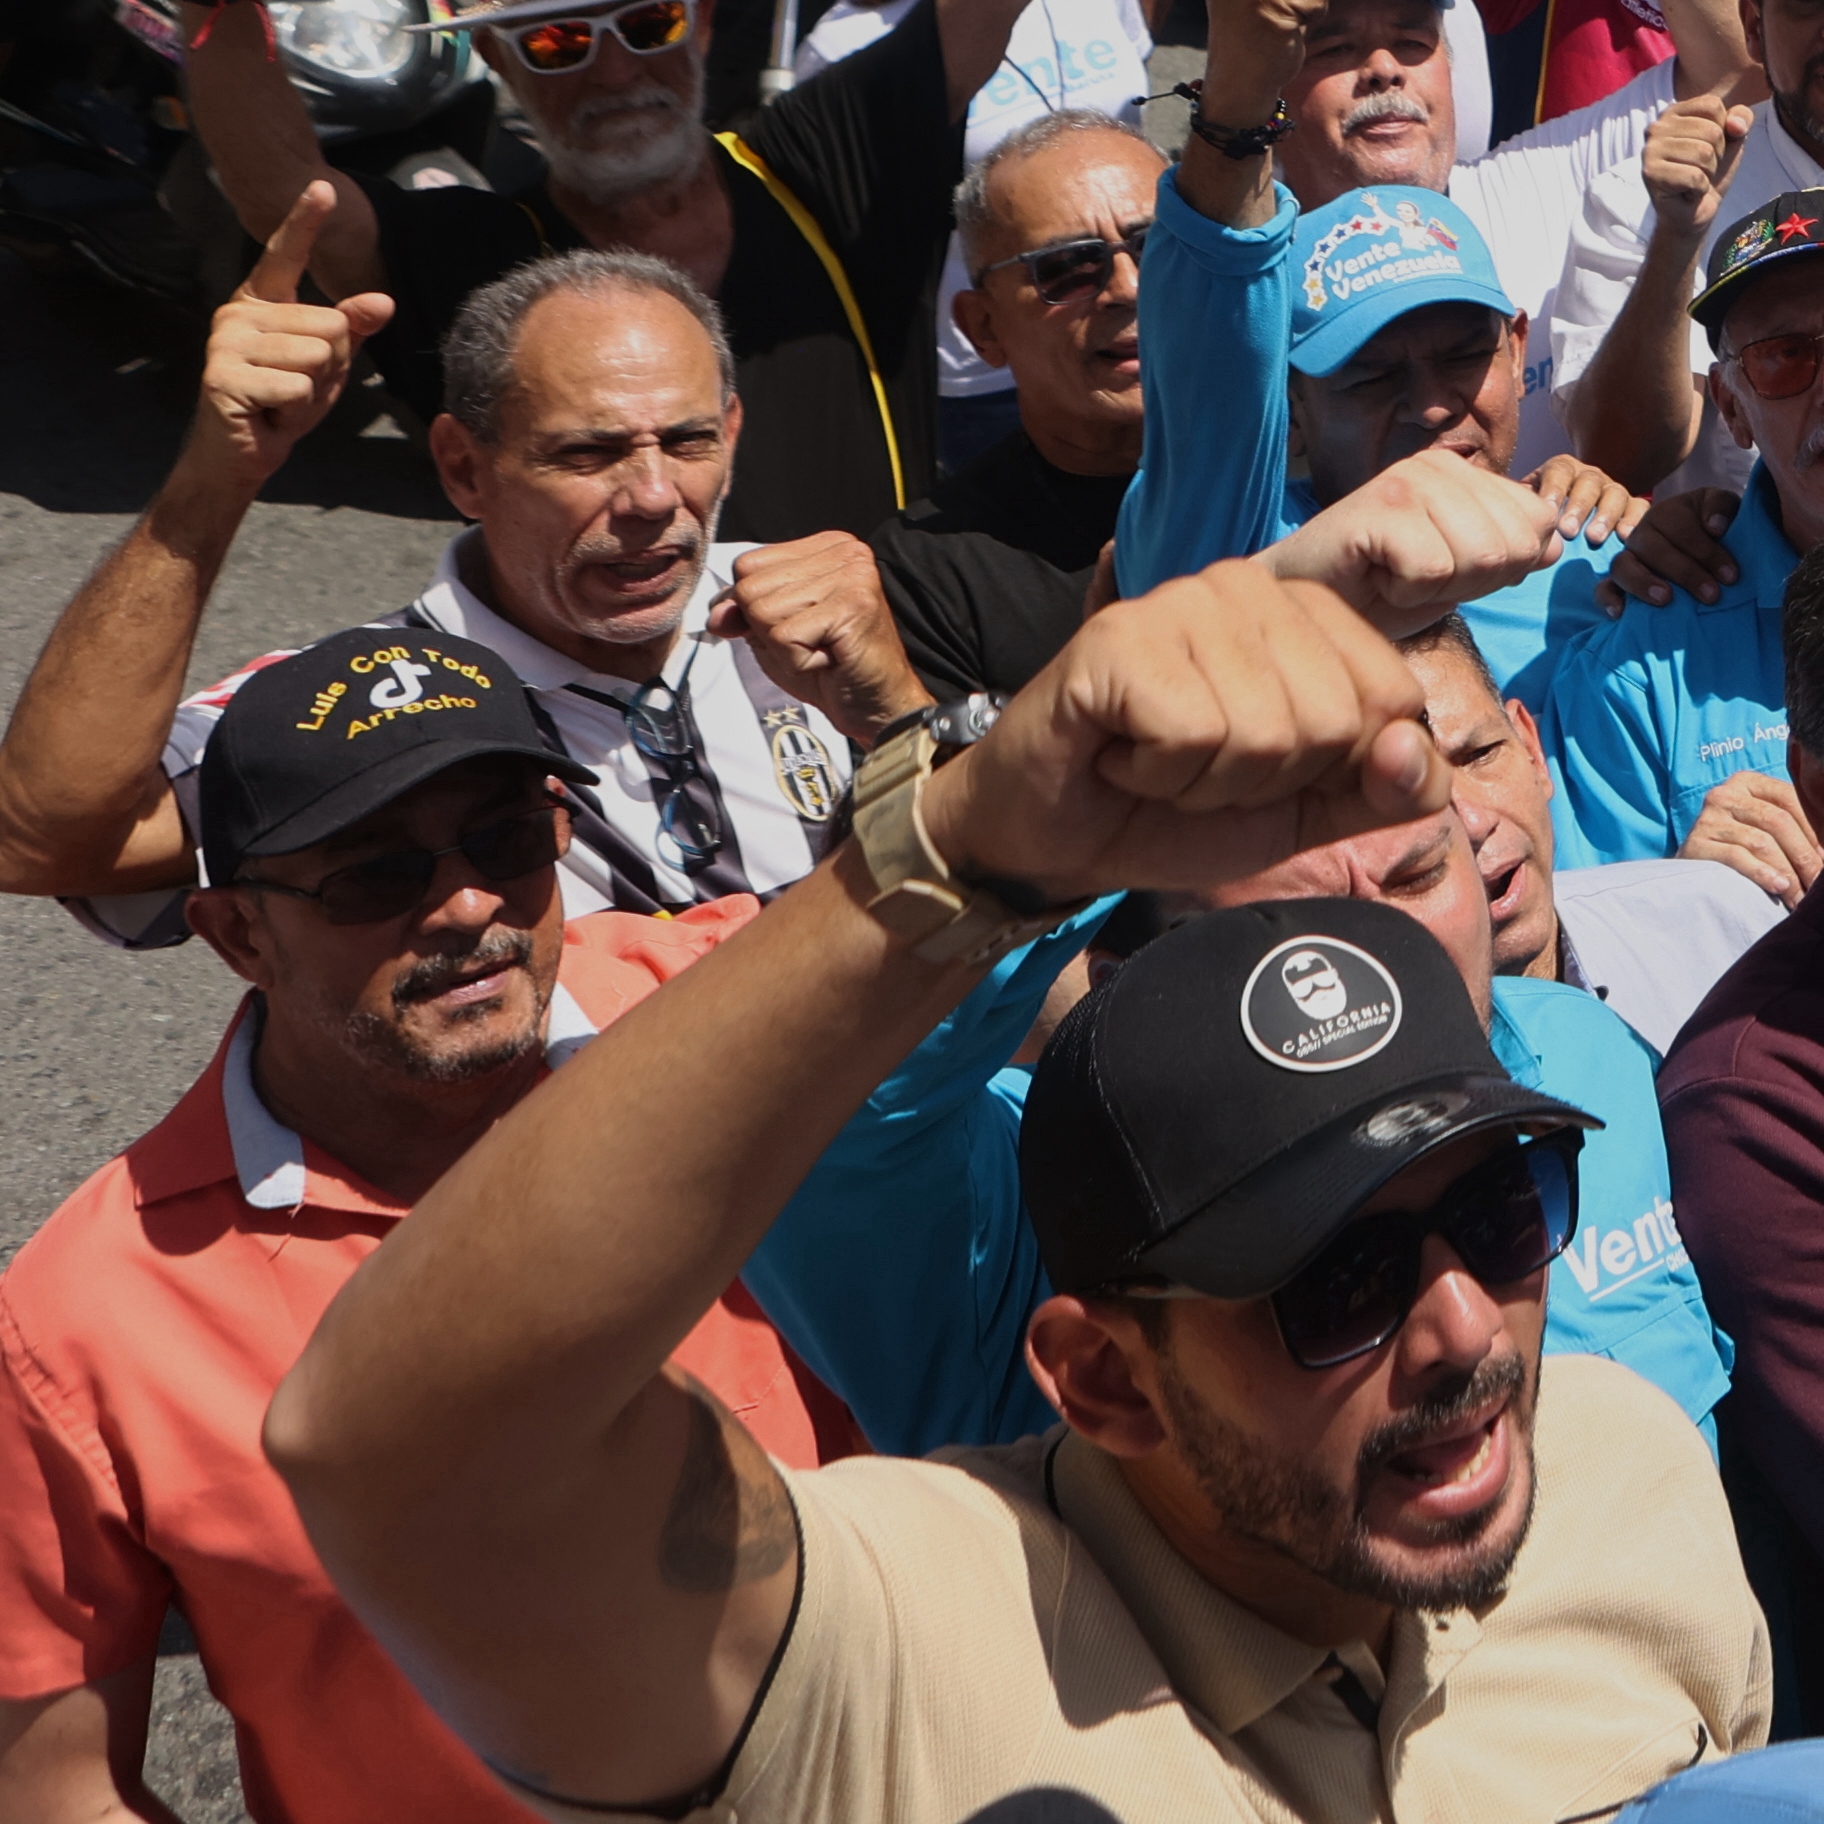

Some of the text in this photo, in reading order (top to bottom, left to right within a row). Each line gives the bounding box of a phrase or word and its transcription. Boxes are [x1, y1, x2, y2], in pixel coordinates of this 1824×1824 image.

[983, 38, 1118, 108] ente
[1325, 239, 1402, 283] Vente
[1331, 249, 1463, 301] Venezuela
[296, 645, 492, 731] Luis Con Todo
[347, 694, 478, 741] Arrecho
[1699, 735, 1746, 764] Plinio
[1281, 1001, 1392, 1055] CALIFORNIA
